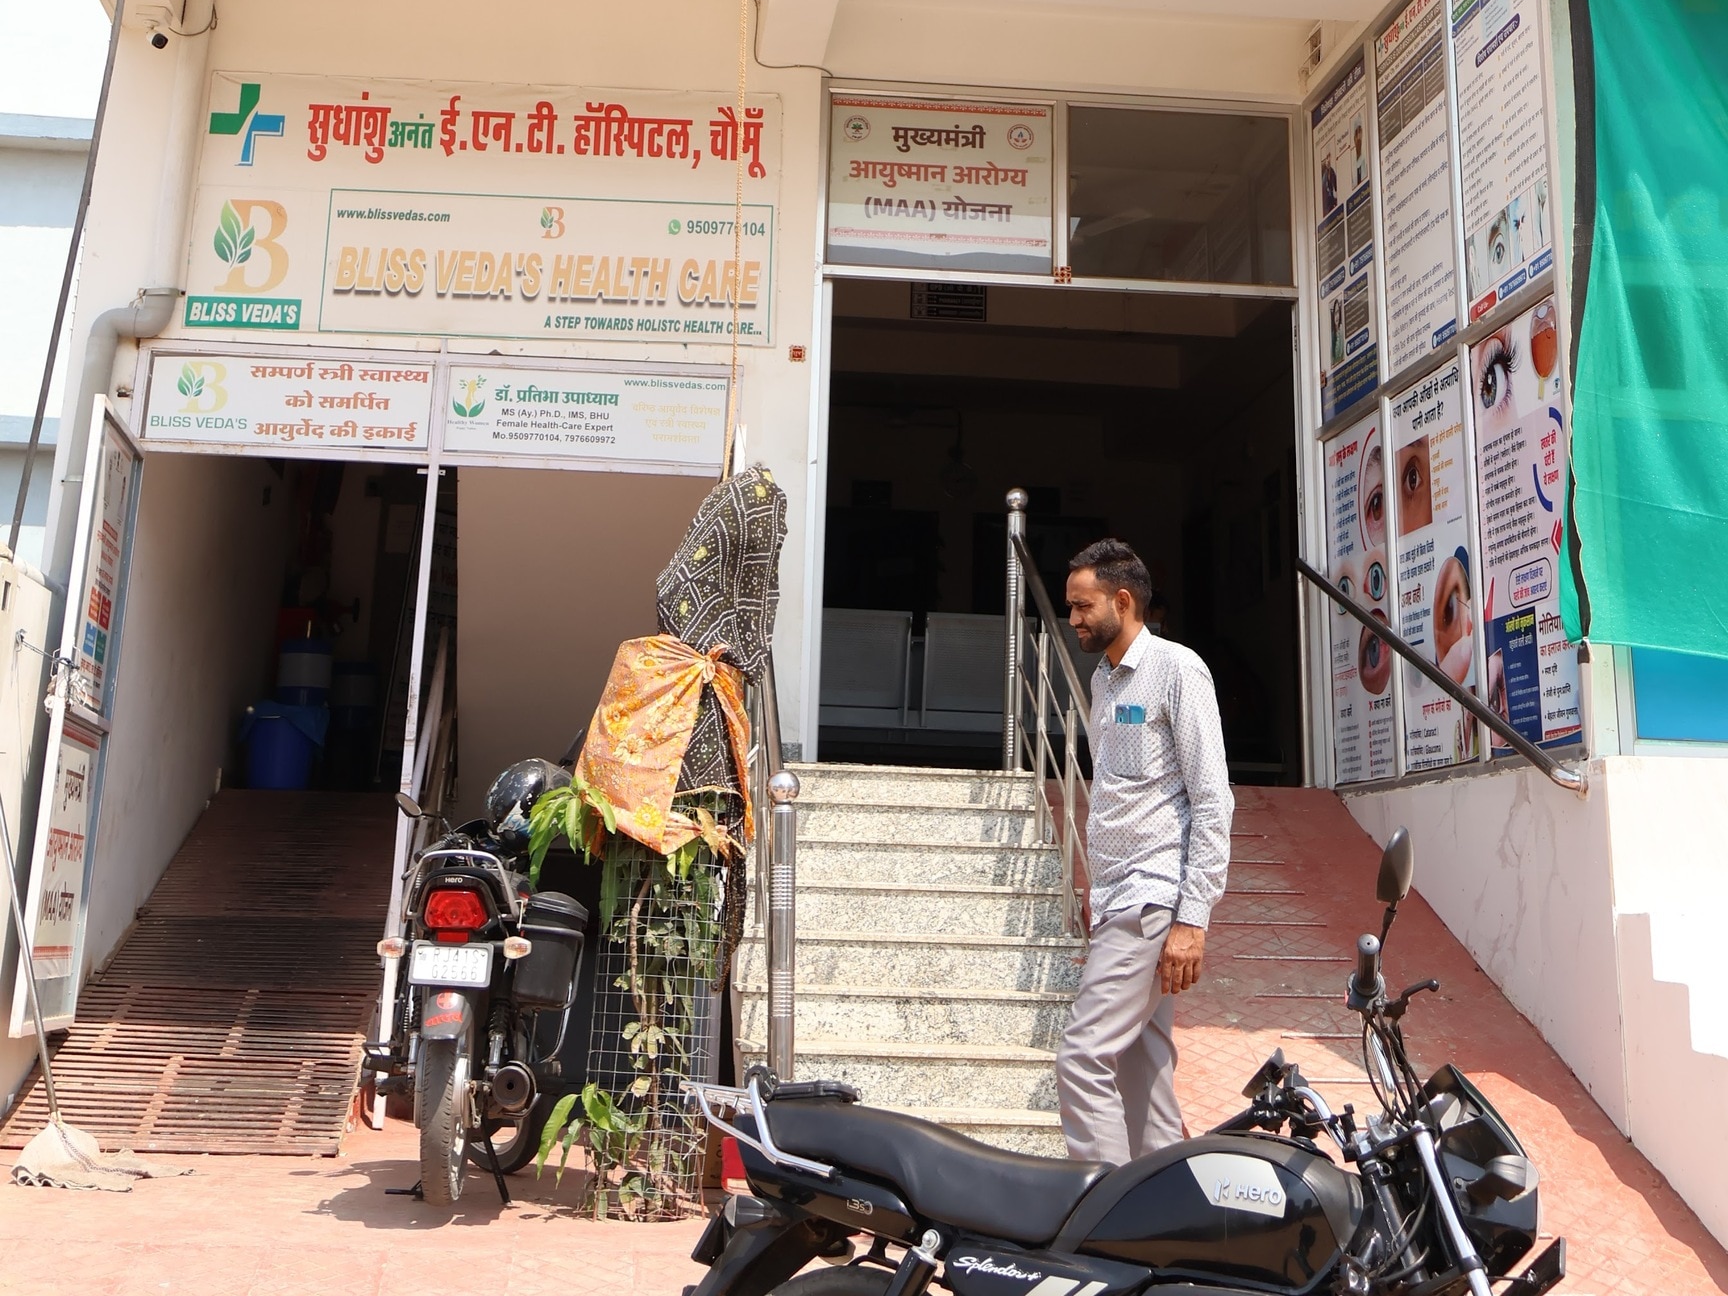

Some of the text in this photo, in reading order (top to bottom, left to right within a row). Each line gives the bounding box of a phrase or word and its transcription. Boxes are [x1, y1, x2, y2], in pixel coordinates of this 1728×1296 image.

[307, 91, 391, 164] सुधांशु
[388, 113, 435, 149] अनंत
[574, 102, 701, 170] हॉस्पिटल,
[891, 124, 986, 153] मुख्यमंत्री
[849, 160, 1028, 188] आयुष्मान आरोग्य
[336, 207, 451, 222] www.blissvedas.com
[865, 196, 1013, 223] (MAA) योजना
[333, 246, 761, 305] BLISS VEDA'S HEALTH CARE
[189, 302, 297, 325] BLISS VEDA'S
[544, 315, 762, 335] A STEP TOWARDS HOLISTC HEALTH CRE...
[318, 363, 353, 382] स्त्री
[358, 368, 429, 383] स्वास्थ्य
[624, 379, 726, 390] www.blissvedas.com
[285, 390, 390, 410] को समर्पित
[495, 385, 619, 406] डॉ. प्रतिभा उपाध्याय
[151, 415, 247, 429] BLISS VEDA'S
[497, 420, 613, 432] Female Health-Care Expert
[568, 412, 587, 420] IMS,
[590, 412, 609, 420] BHU
[253, 419, 418, 441] आयुर्वेद की इकाई
[565, 435, 616, 444] 7976609972
[1538, 607, 1564, 638] मोतिया
[1235, 1183, 1283, 1206] Hero
